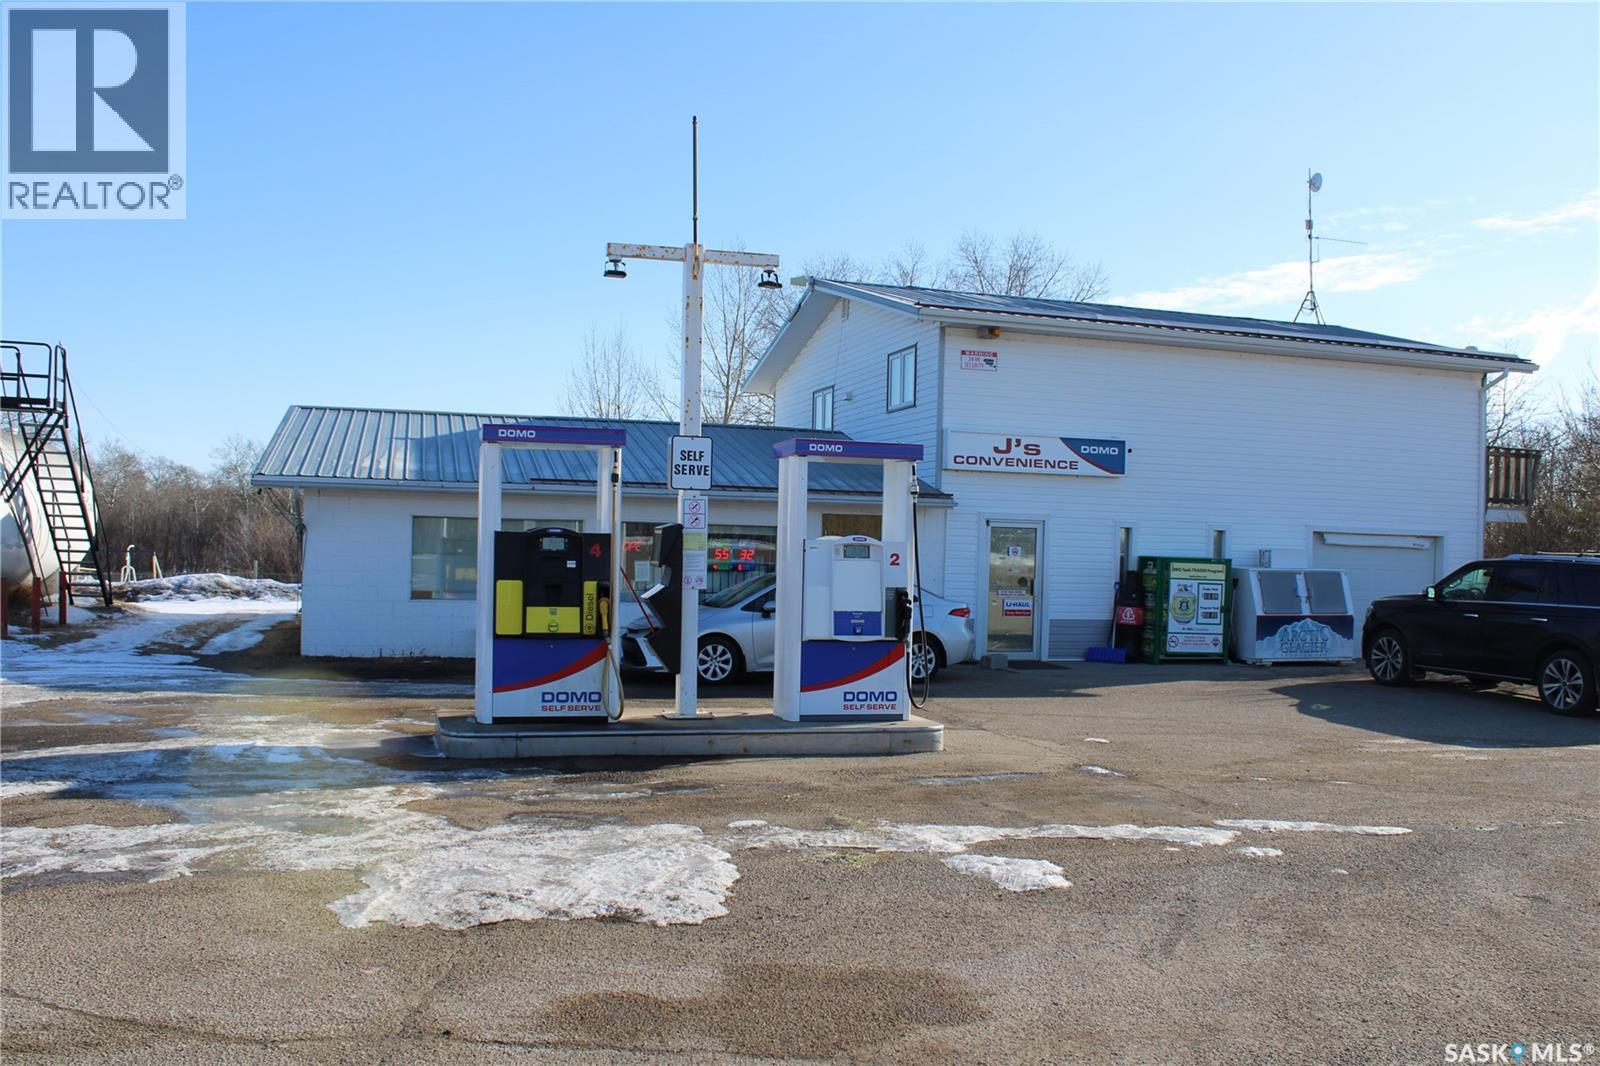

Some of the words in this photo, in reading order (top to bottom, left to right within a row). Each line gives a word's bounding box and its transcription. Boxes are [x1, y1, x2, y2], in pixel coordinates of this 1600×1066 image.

[498, 429, 536, 438] DOMO
[809, 443, 843, 452] DOMO
[993, 438, 1041, 456] J's
[1080, 445, 1119, 455] DOMO
[680, 449, 704, 461] SELF
[953, 455, 1079, 470] CONVENIENCE
[674, 463, 710, 476] SERVE
[590, 543, 602, 557] 4
[889, 553, 900, 566] 2
[585, 593, 594, 621] Diesel
[1280, 627, 1329, 642] ARCTIC
[1280, 641, 1329, 654] GLACIER
[541, 691, 602, 703] DOMO
[843, 691, 898, 702] DOMO
[541, 704, 566, 712] SELF
[567, 704, 601, 712] SERVE
[843, 703, 866, 711] SELF
